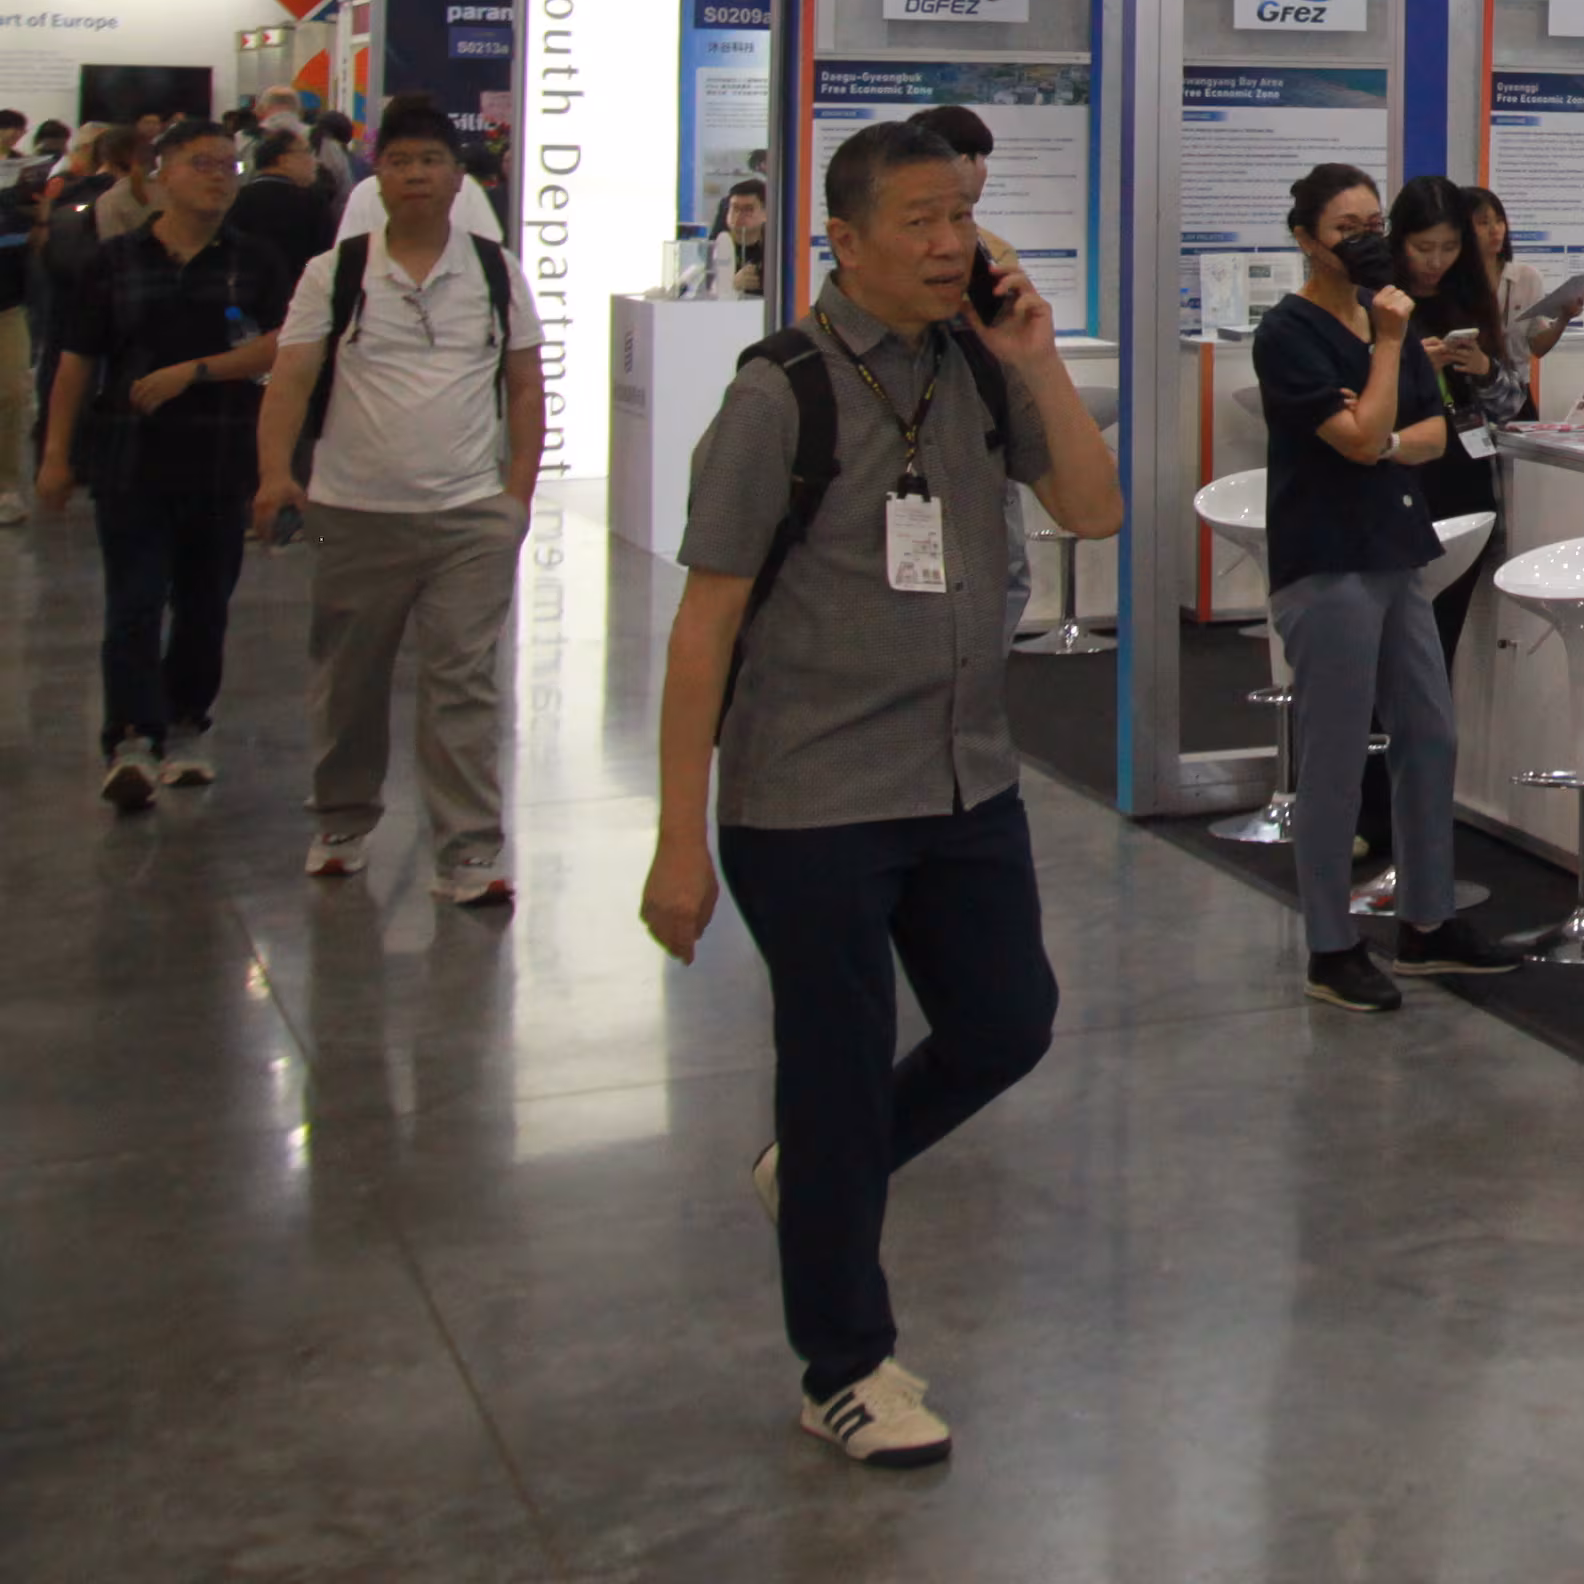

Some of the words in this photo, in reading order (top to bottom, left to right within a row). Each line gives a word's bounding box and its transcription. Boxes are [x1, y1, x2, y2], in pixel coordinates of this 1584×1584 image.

[26, 11, 48, 28] of
[50, 13, 120, 32] Europe
[820, 70, 924, 84] Daegu-Gyeongbuk
[1183, 77, 1237, 90] wangyang
[820, 83, 847, 95] Free
[849, 83, 904, 96] Economic
[905, 84, 934, 96] Zone
[1184, 87, 1203, 98] ree
[1204, 87, 1254, 99] Economic
[1255, 88, 1281, 99] Zone
[1496, 81, 1540, 95] Gyeonggi
[1496, 92, 1519, 105] Free
[1519, 93, 1565, 105] Economic
[524, 144, 582, 478] Department
